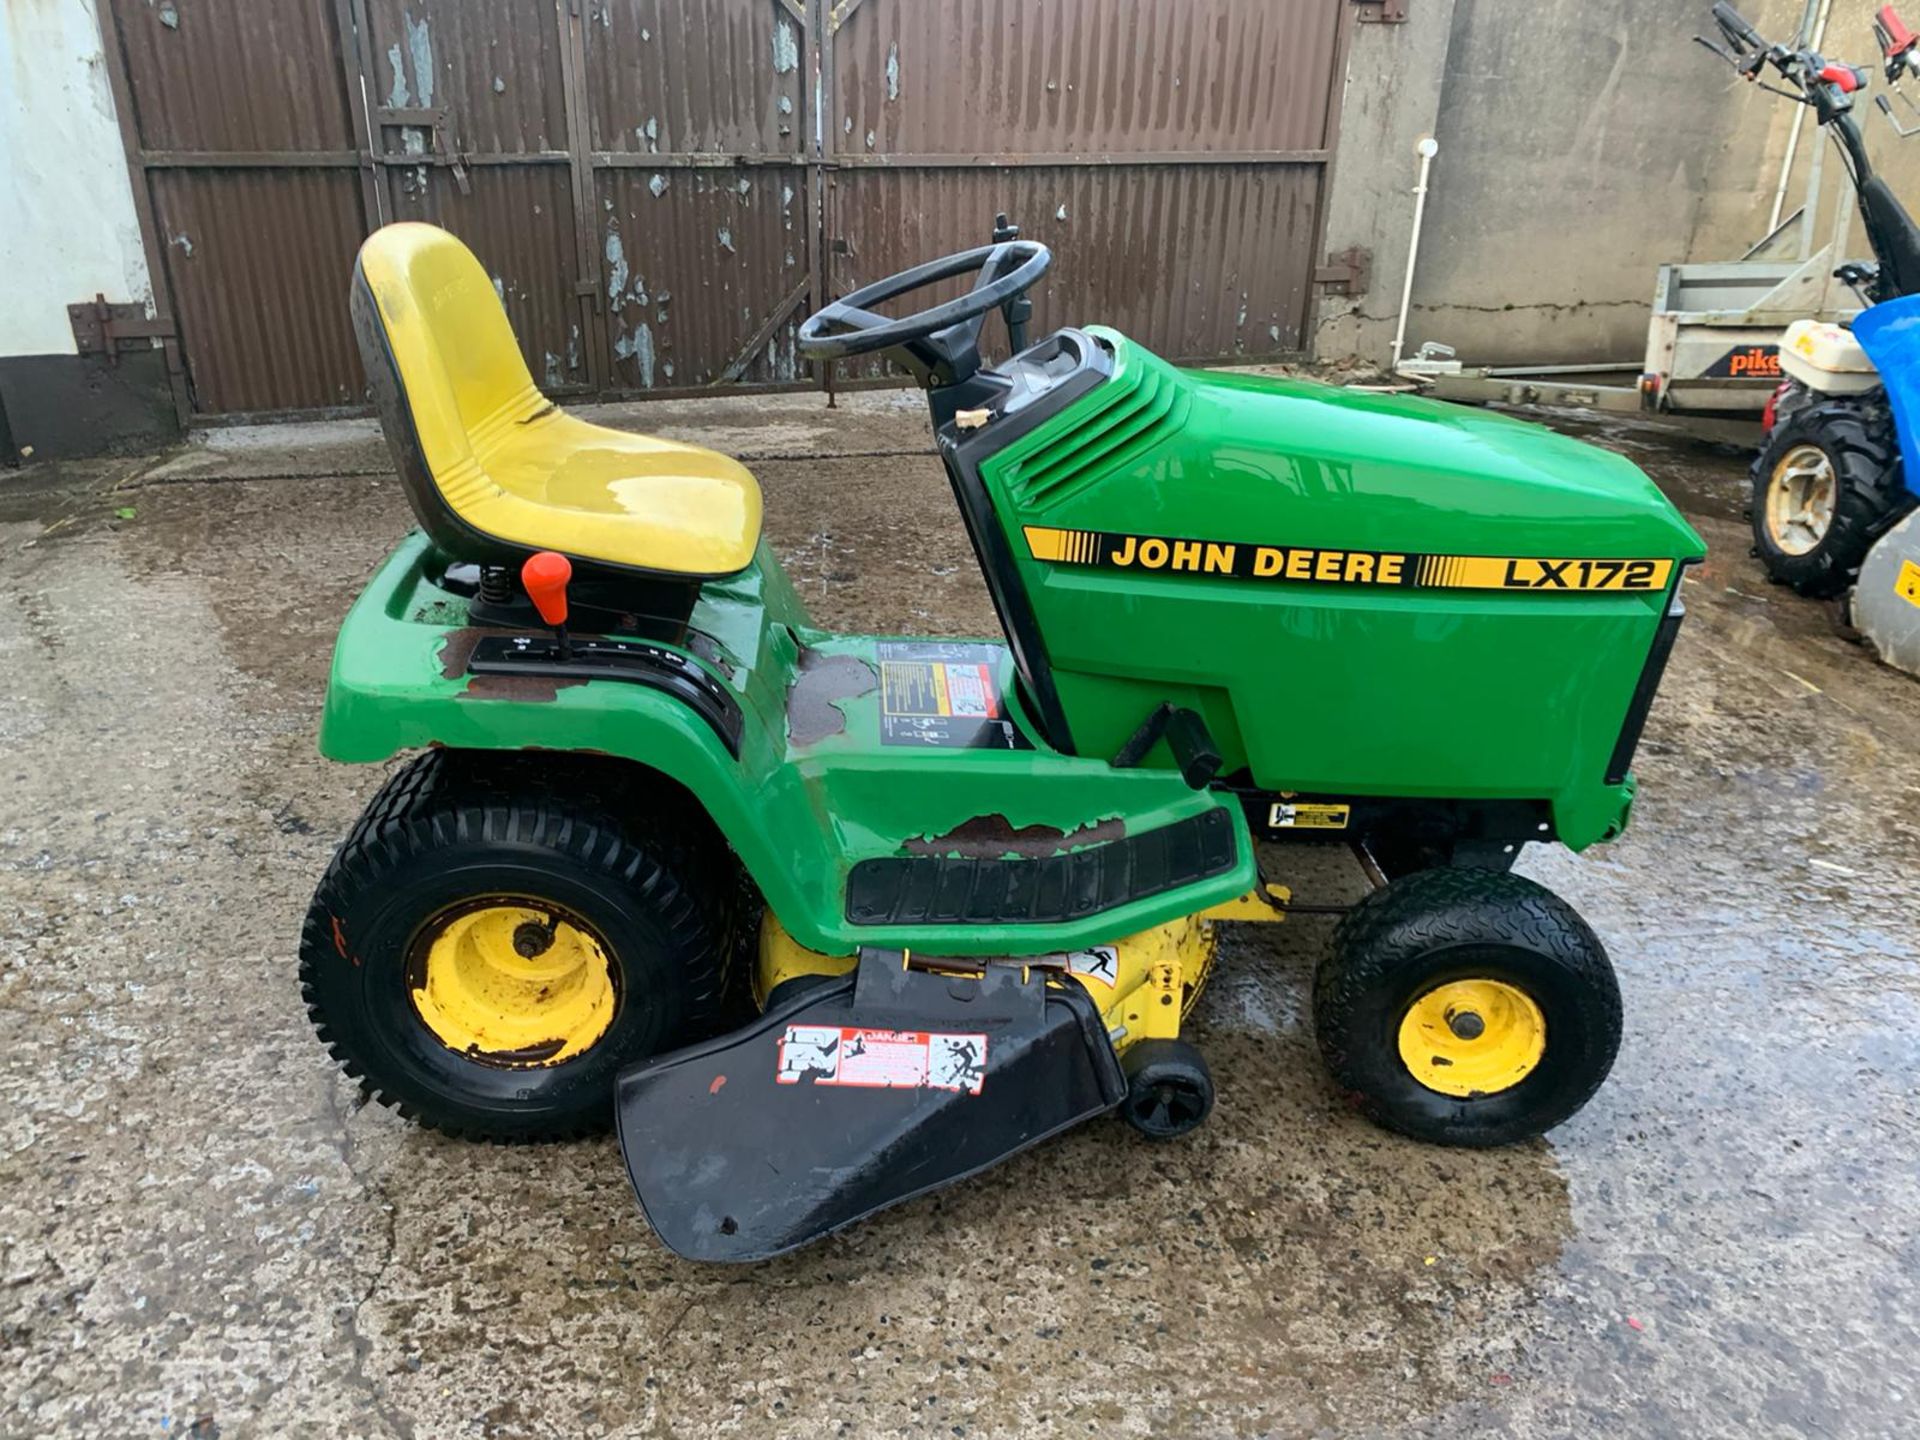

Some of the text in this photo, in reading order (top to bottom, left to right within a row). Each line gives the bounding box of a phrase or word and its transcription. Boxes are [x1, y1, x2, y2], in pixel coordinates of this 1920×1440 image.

[1112, 537, 1655, 588] JOHN DEERE LX172
